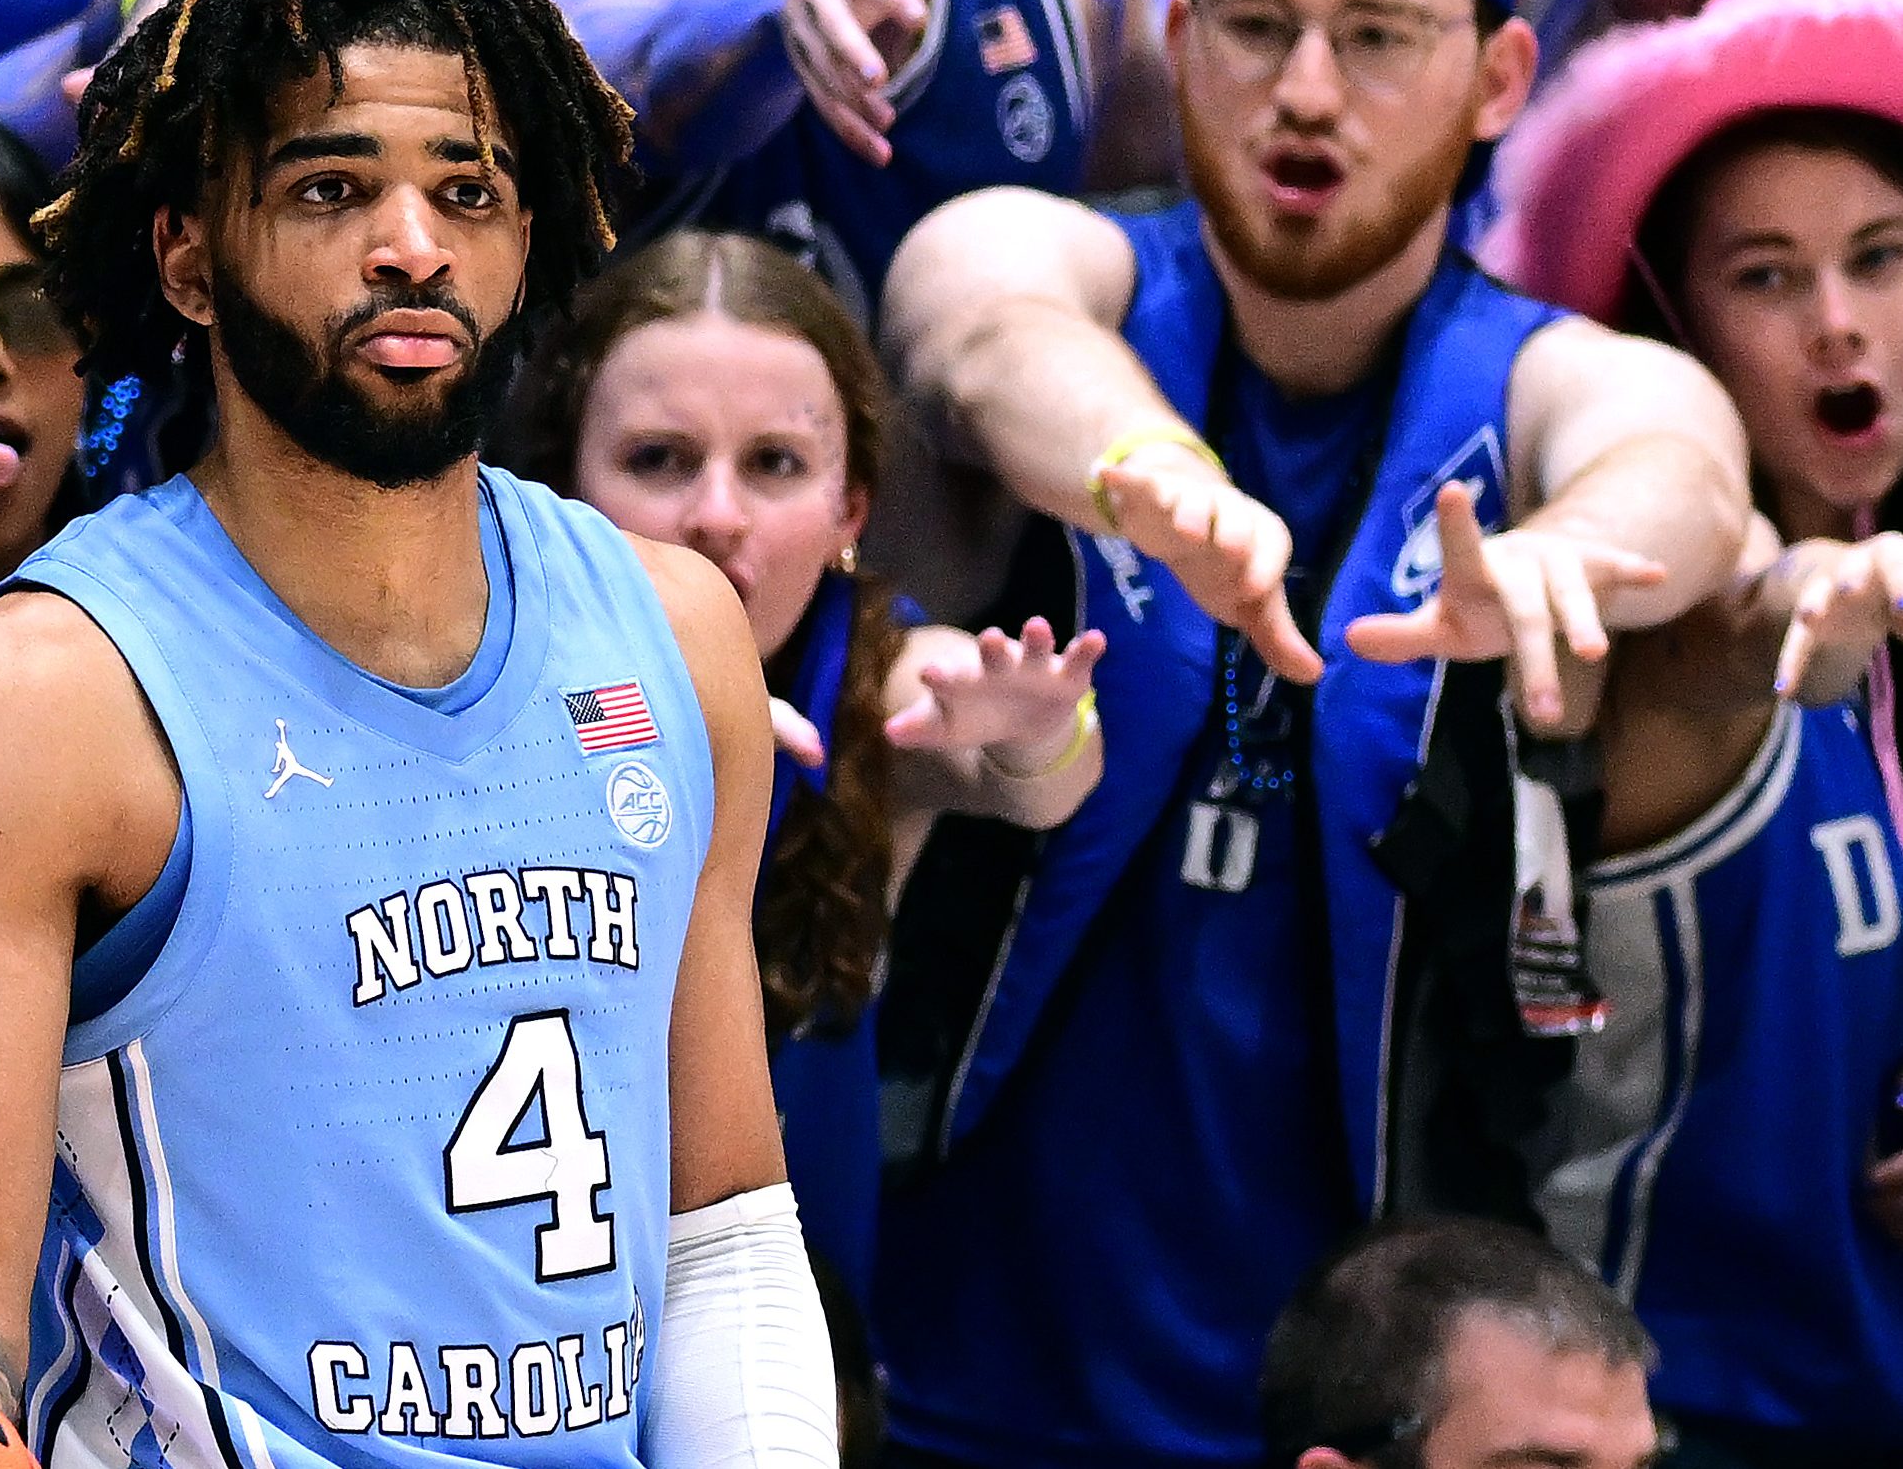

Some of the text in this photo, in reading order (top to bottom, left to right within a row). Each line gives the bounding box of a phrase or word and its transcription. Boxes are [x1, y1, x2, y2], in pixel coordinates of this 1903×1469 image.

[619, 791, 663, 811] ACC
[1180, 801, 1260, 893] D
[346, 867, 640, 1007] NORTH
[1809, 811, 1902, 958] D
[443, 1007, 616, 1284] 4
[307, 1290, 644, 1439] CAROLI
